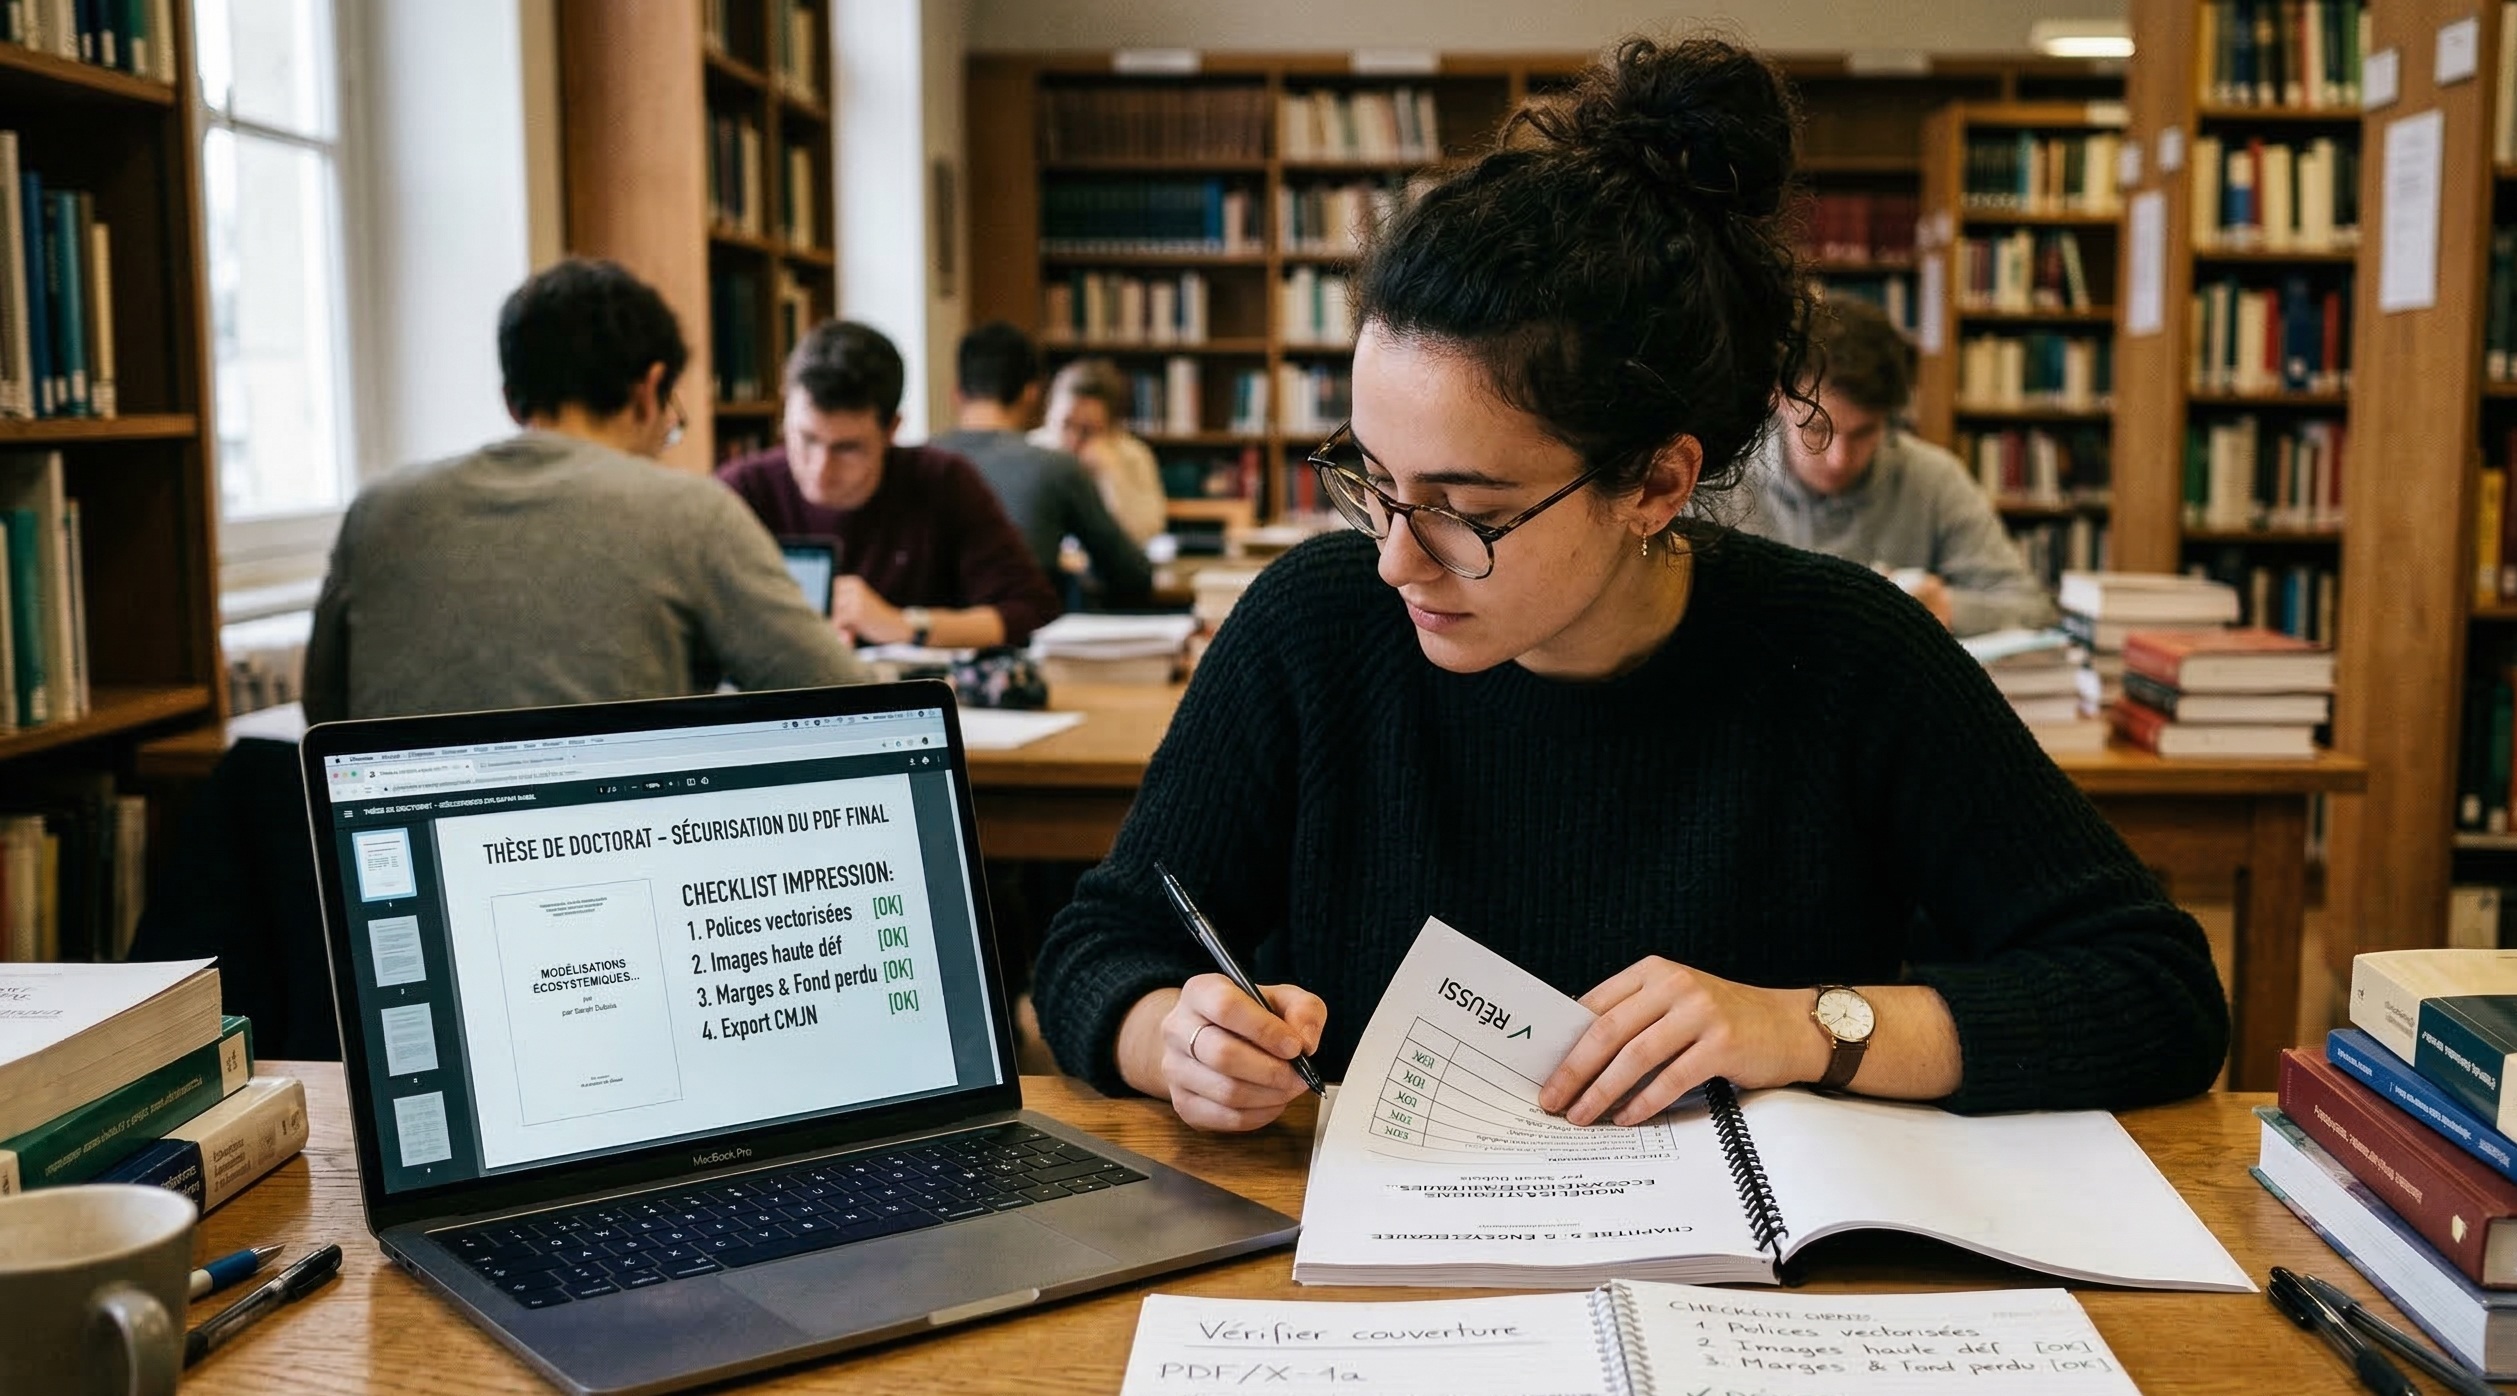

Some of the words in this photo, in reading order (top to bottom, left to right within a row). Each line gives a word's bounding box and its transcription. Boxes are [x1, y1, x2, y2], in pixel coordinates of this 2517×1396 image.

[483, 837, 539, 864] THÈSE
[542, 837, 566, 858] DE
[569, 828, 652, 856] DOCTORAT
[671, 814, 784, 845] SÉCURISATION
[788, 812, 809, 832] DU
[813, 808, 841, 830] PDF
[846, 804, 889, 827] FINAL
[682, 873, 778, 907] CHECKLIST
[782, 860, 894, 895] IMPRESSION:
[687, 920, 702, 941] 1.
[706, 915, 762, 939] Polices
[765, 903, 853, 931] vectorisées
[873, 894, 904, 920] [OK]
[540, 958, 627, 980] MODÉLISATIONS
[691, 954, 707, 975] 2.
[711, 950, 768, 974] Images
[771, 940, 814, 964] haute
[819, 934, 843, 957] déf
[877, 926, 909, 952] [OK]
[696, 987, 712, 1008] 3.
[716, 982, 774, 1006] Marges
[778, 977, 790, 996] &
[794, 969, 831, 994] Fond
[835, 963, 878, 993] perdu
[883, 957, 914, 984] [OK]
[1438, 977, 1511, 1031] RÉUSSI
[702, 1020, 718, 1041] 4.
[721, 1012, 772, 1041] Export
[774, 1004, 818, 1030] CMJN
[888, 989, 919, 1015] [OK]
[1200, 1319, 1328, 1345] Vérifier
[1352, 1321, 1528, 1341] couverture
[1728, 1321, 1819, 1337] Polices
[1840, 1325, 1981, 1338] vectorisées
[1736, 1339, 1844, 1358] Images
[1863, 1342, 1936, 1355] haute
[2034, 1341, 2094, 1355] [OK]
[1741, 1357, 1846, 1375] Marges
[1969, 1358, 2035, 1375] perdu
